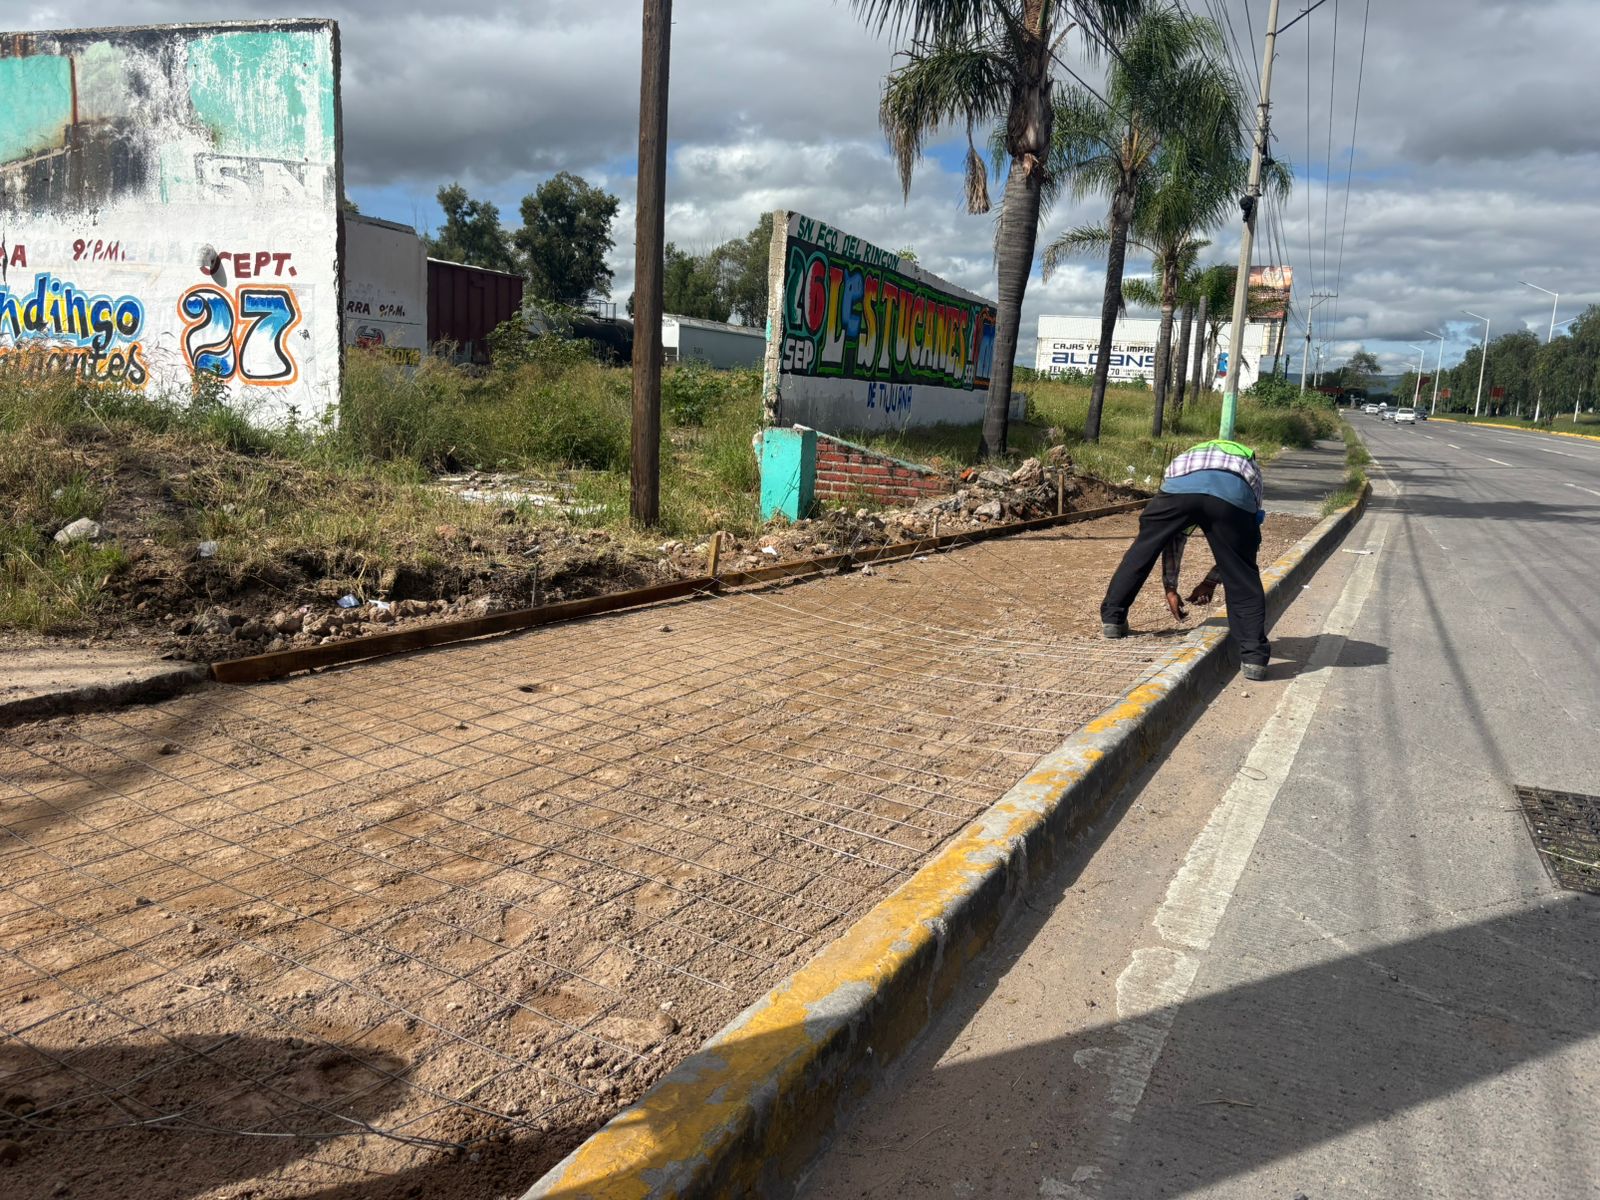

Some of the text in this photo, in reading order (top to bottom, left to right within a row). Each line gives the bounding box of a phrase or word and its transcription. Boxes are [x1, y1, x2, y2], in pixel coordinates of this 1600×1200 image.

[842, 234, 861, 260] DEL
[863, 243, 900, 271] RINCON
[178, 284, 302, 386] 27
[1094, 344, 1125, 352] PEL
[783, 337, 814, 370] SEP
